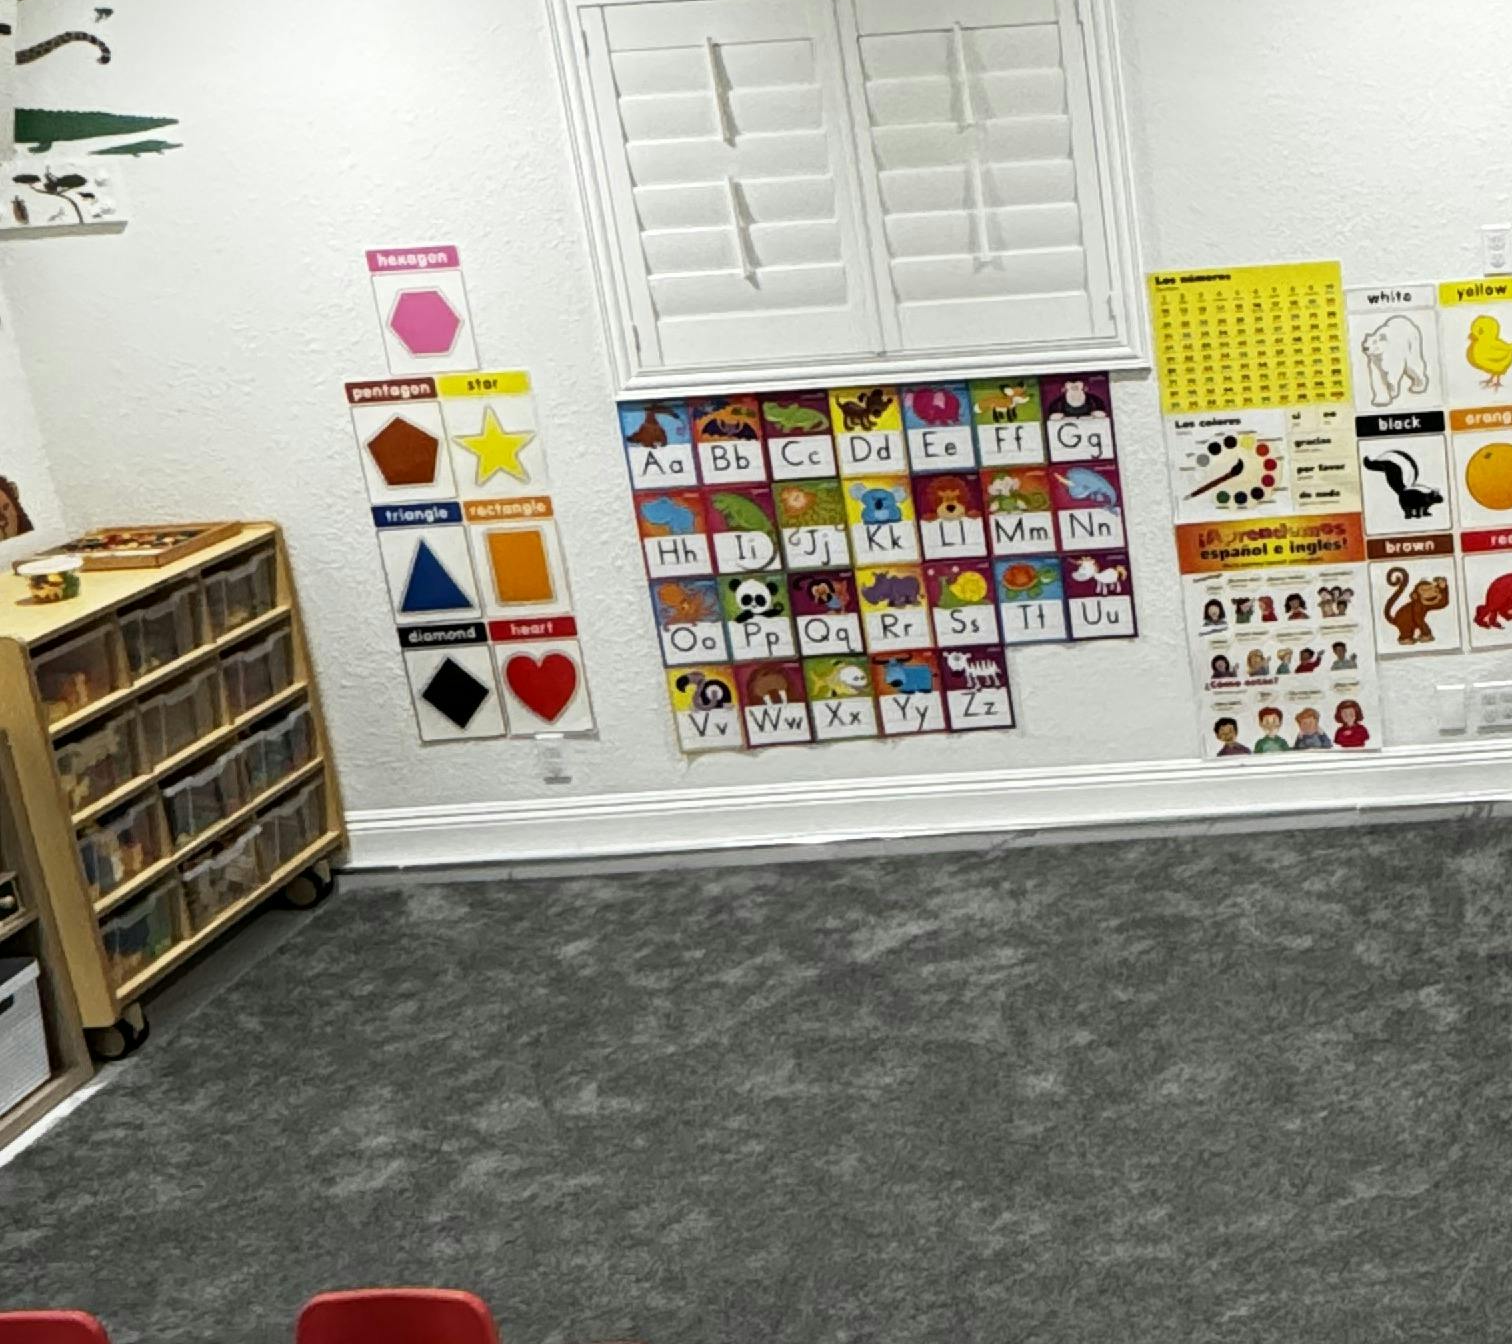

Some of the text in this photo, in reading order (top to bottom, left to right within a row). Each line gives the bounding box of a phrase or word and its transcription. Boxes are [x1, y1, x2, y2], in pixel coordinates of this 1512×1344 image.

[377, 251, 448, 268] hexagon
[1367, 291, 1412, 304] white
[1457, 282, 1508, 301] yellow
[352, 382, 431, 401] pentagon
[467, 378, 498, 391] star
[1378, 418, 1422, 431] black
[781, 440, 822, 466] Cc
[850, 435, 891, 462] Dd
[922, 431, 957, 458] Ee
[994, 426, 1024, 454] Ff
[1057, 422, 1103, 458] Gg
[641, 450, 684, 477] Aa
[710, 444, 750, 472] Bb
[385, 508, 448, 523] triangle
[469, 500, 547, 517] rectangle
[866, 524, 903, 551] Kk
[939, 520, 965, 547] Ll
[994, 517, 1049, 544] Mm
[1069, 512, 1111, 538] Nn
[657, 538, 697, 566] Hh
[735, 534, 759, 560] Ii
[803, 529, 831, 565] Jj
[1201, 542, 1268, 561] español
[1274, 545, 1284, 554] e
[1385, 539, 1435, 554] brown
[950, 609, 980, 634] Ss
[1017, 604, 1045, 630] Tt
[1081, 600, 1119, 626] Uu
[408, 626, 476, 643] diamond
[510, 621, 554, 636] heart
[670, 626, 716, 652] Oo
[743, 622, 779, 656] Pp
[804, 618, 855, 652] Qq
[880, 613, 914, 640] Rr
[826, 702, 861, 727] Xx
[893, 696, 928, 731] Yy
[962, 692, 999, 718] Zz
[689, 713, 728, 737] Vv
[750, 707, 803, 733] Ww
